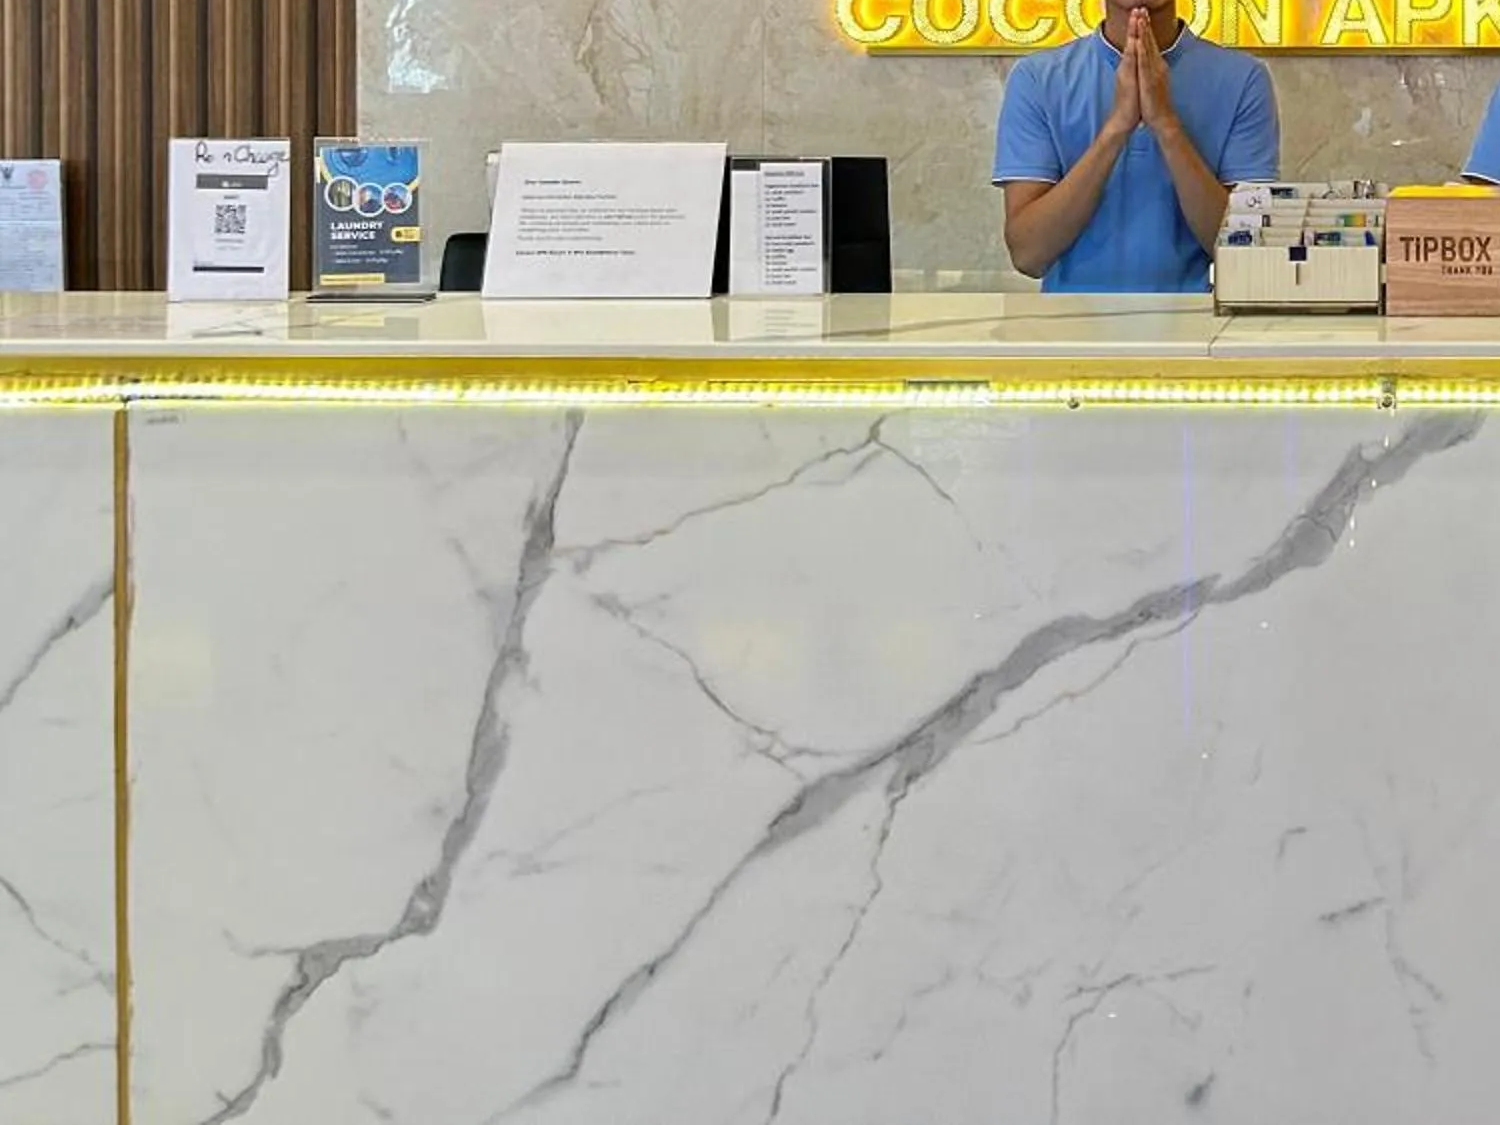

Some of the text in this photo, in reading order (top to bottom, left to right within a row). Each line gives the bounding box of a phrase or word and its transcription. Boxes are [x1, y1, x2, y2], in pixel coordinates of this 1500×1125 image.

[330, 221, 384, 230] LAUNDRY
[330, 231, 376, 240] SERVICE
[1441, 265, 1471, 275] THANK
